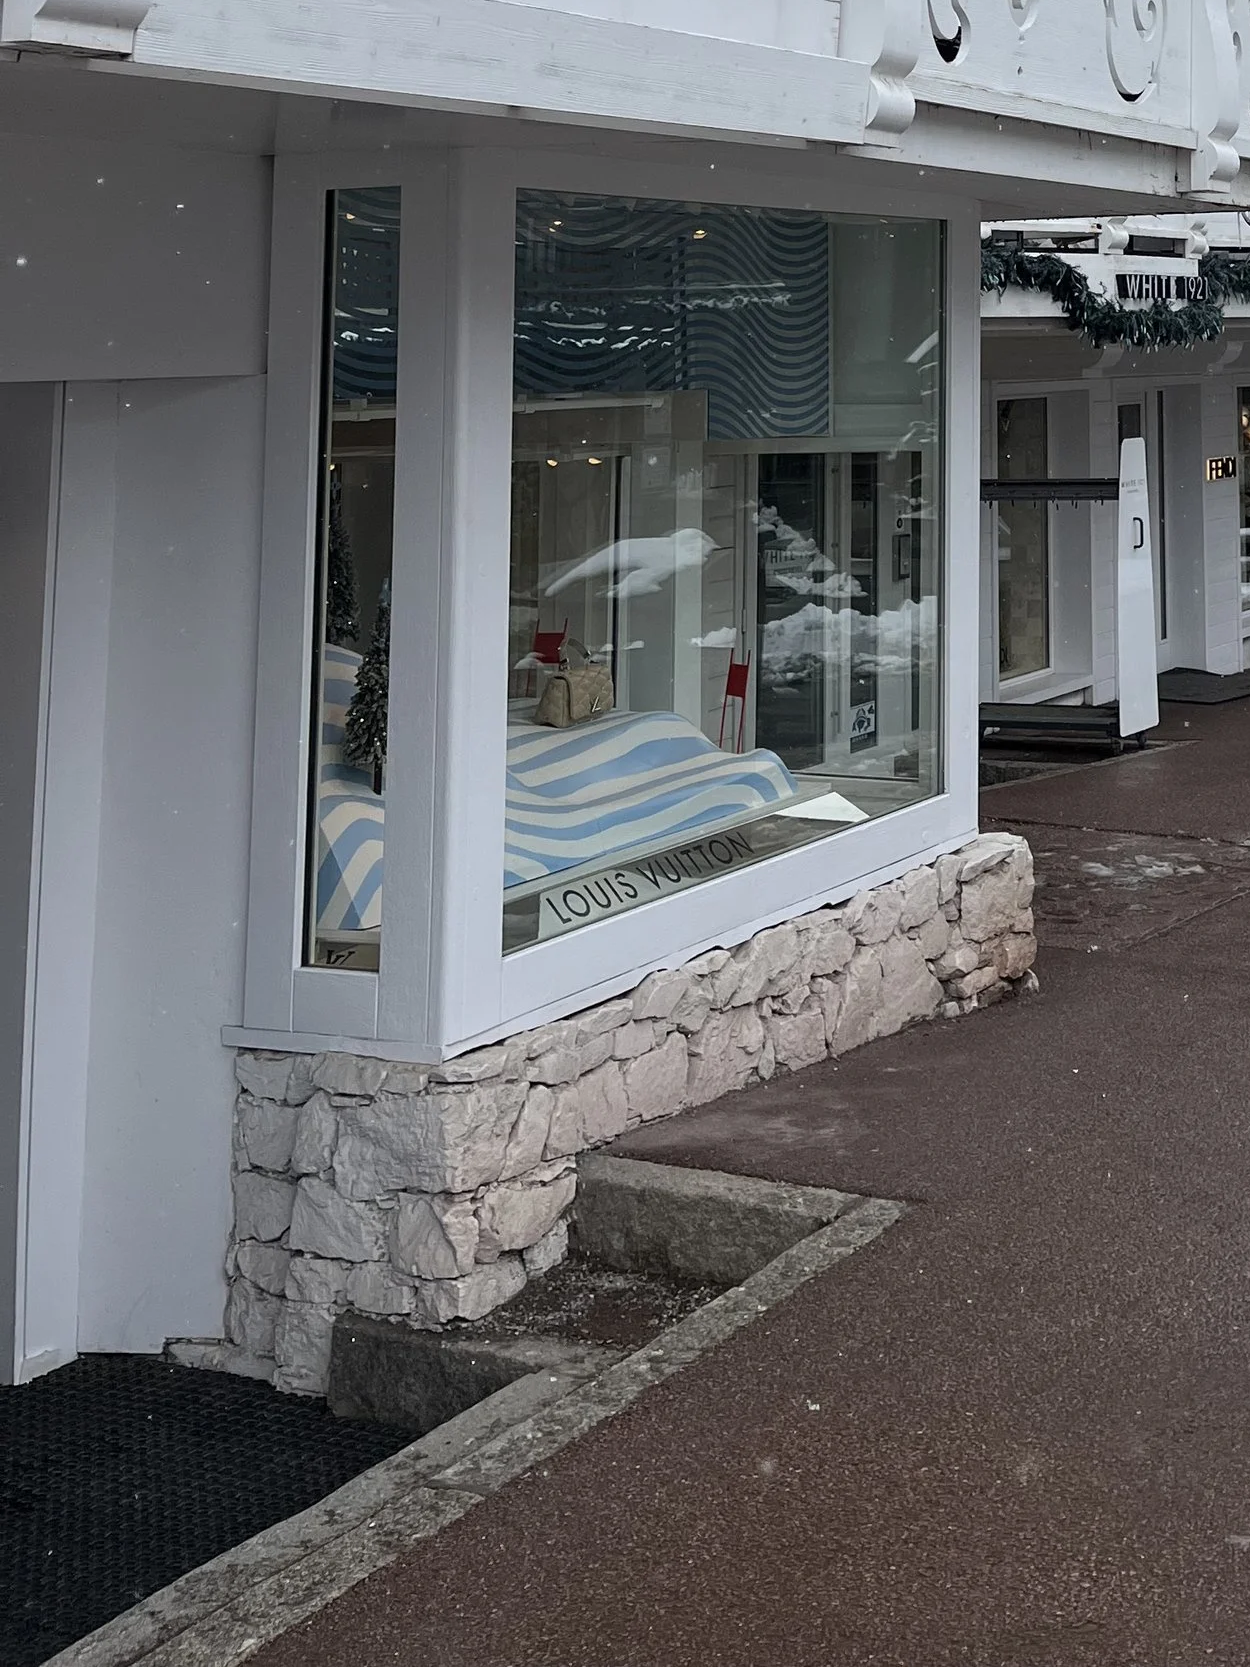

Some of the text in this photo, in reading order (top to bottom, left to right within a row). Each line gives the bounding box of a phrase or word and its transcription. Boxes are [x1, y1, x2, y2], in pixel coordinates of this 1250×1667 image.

[1126, 275, 1208, 300] WHITE 1921
[1206, 457, 1237, 481] FENDI
[546, 832, 755, 924] LOUIS VUITTON
